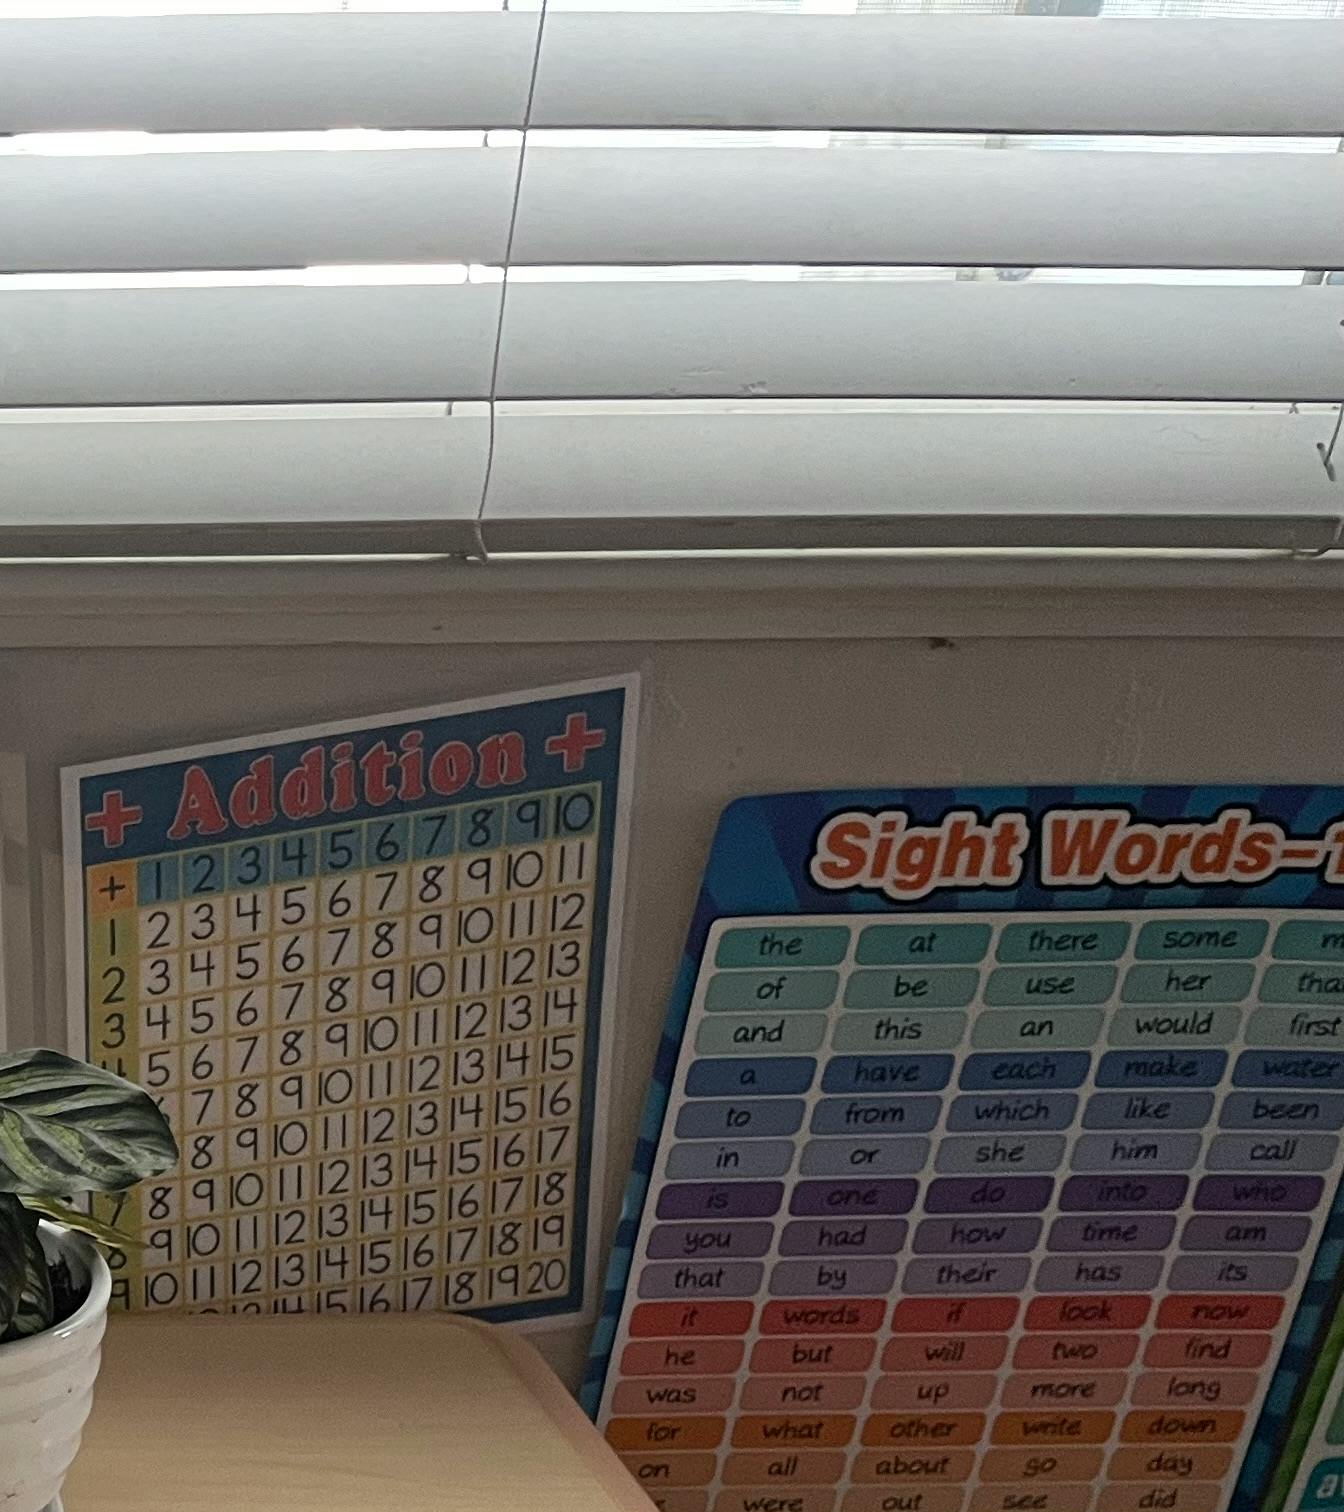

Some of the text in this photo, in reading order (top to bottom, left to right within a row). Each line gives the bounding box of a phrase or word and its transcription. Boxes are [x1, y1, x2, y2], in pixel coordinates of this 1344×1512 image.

[168, 730, 526, 840] Addition
[193, 854, 215, 893] 2
[237, 845, 262, 885] 3
[282, 837, 307, 876] 4
[329, 829, 355, 870] 5
[376, 823, 399, 862] 6
[423, 814, 447, 855] 7
[468, 808, 494, 847] 8
[516, 799, 541, 838] 9
[554, 792, 594, 833] 10
[814, 812, 1026, 897] Sight
[760, 929, 1237, 956] the at there some
[757, 969, 1212, 999] of be use her
[733, 1011, 1342, 1043] and this an would first
[726, 1096, 1319, 1127] to from which like been
[716, 1139, 1298, 1168] in or she him call
[684, 1223, 1266, 1254] you had how time am
[675, 1262, 1247, 1290] that by their has its
[665, 1337, 1232, 1366] he but will two find
[646, 1376, 1221, 1405] was not up more long
